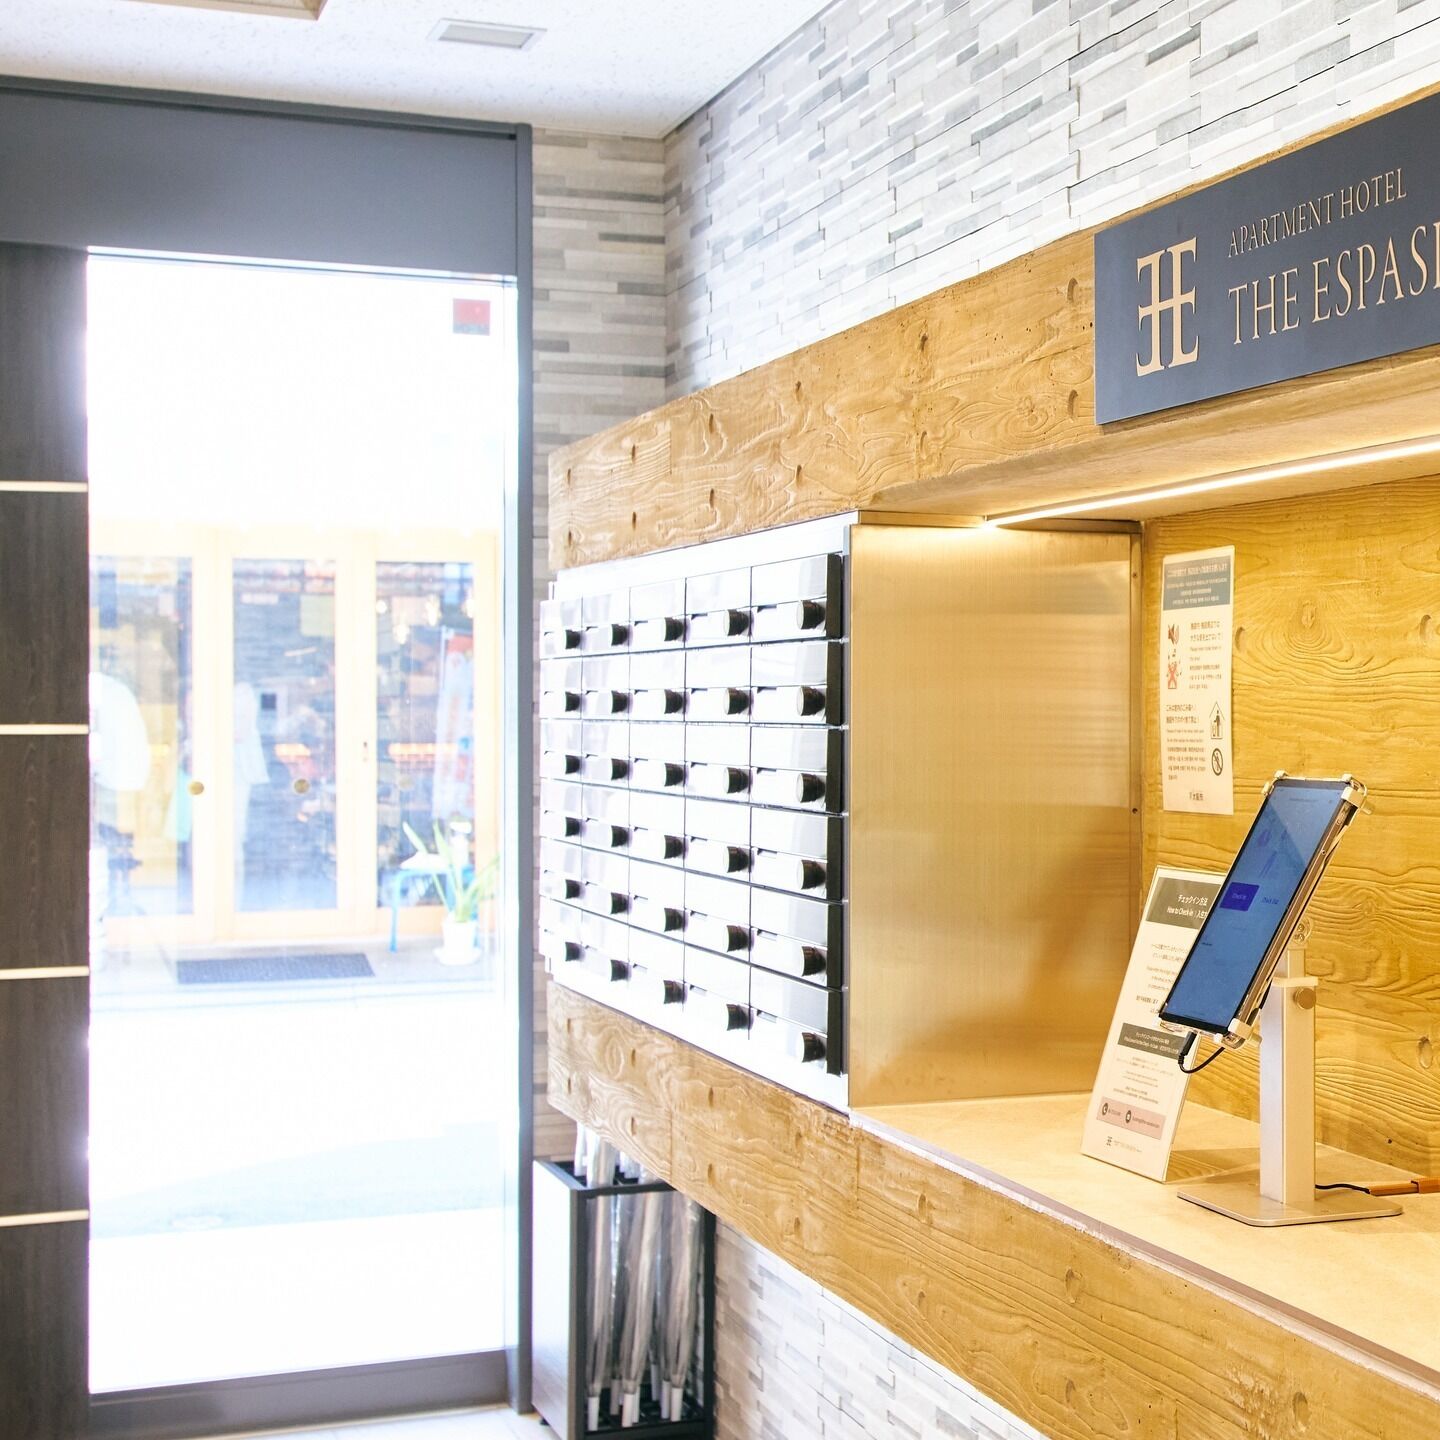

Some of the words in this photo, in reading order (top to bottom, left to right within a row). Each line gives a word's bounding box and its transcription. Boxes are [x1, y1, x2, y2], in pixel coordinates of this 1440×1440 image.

[1228, 192, 1335, 259] APARTMENT
[1339, 167, 1408, 220] HOTEL
[1227, 266, 1301, 345] THE
